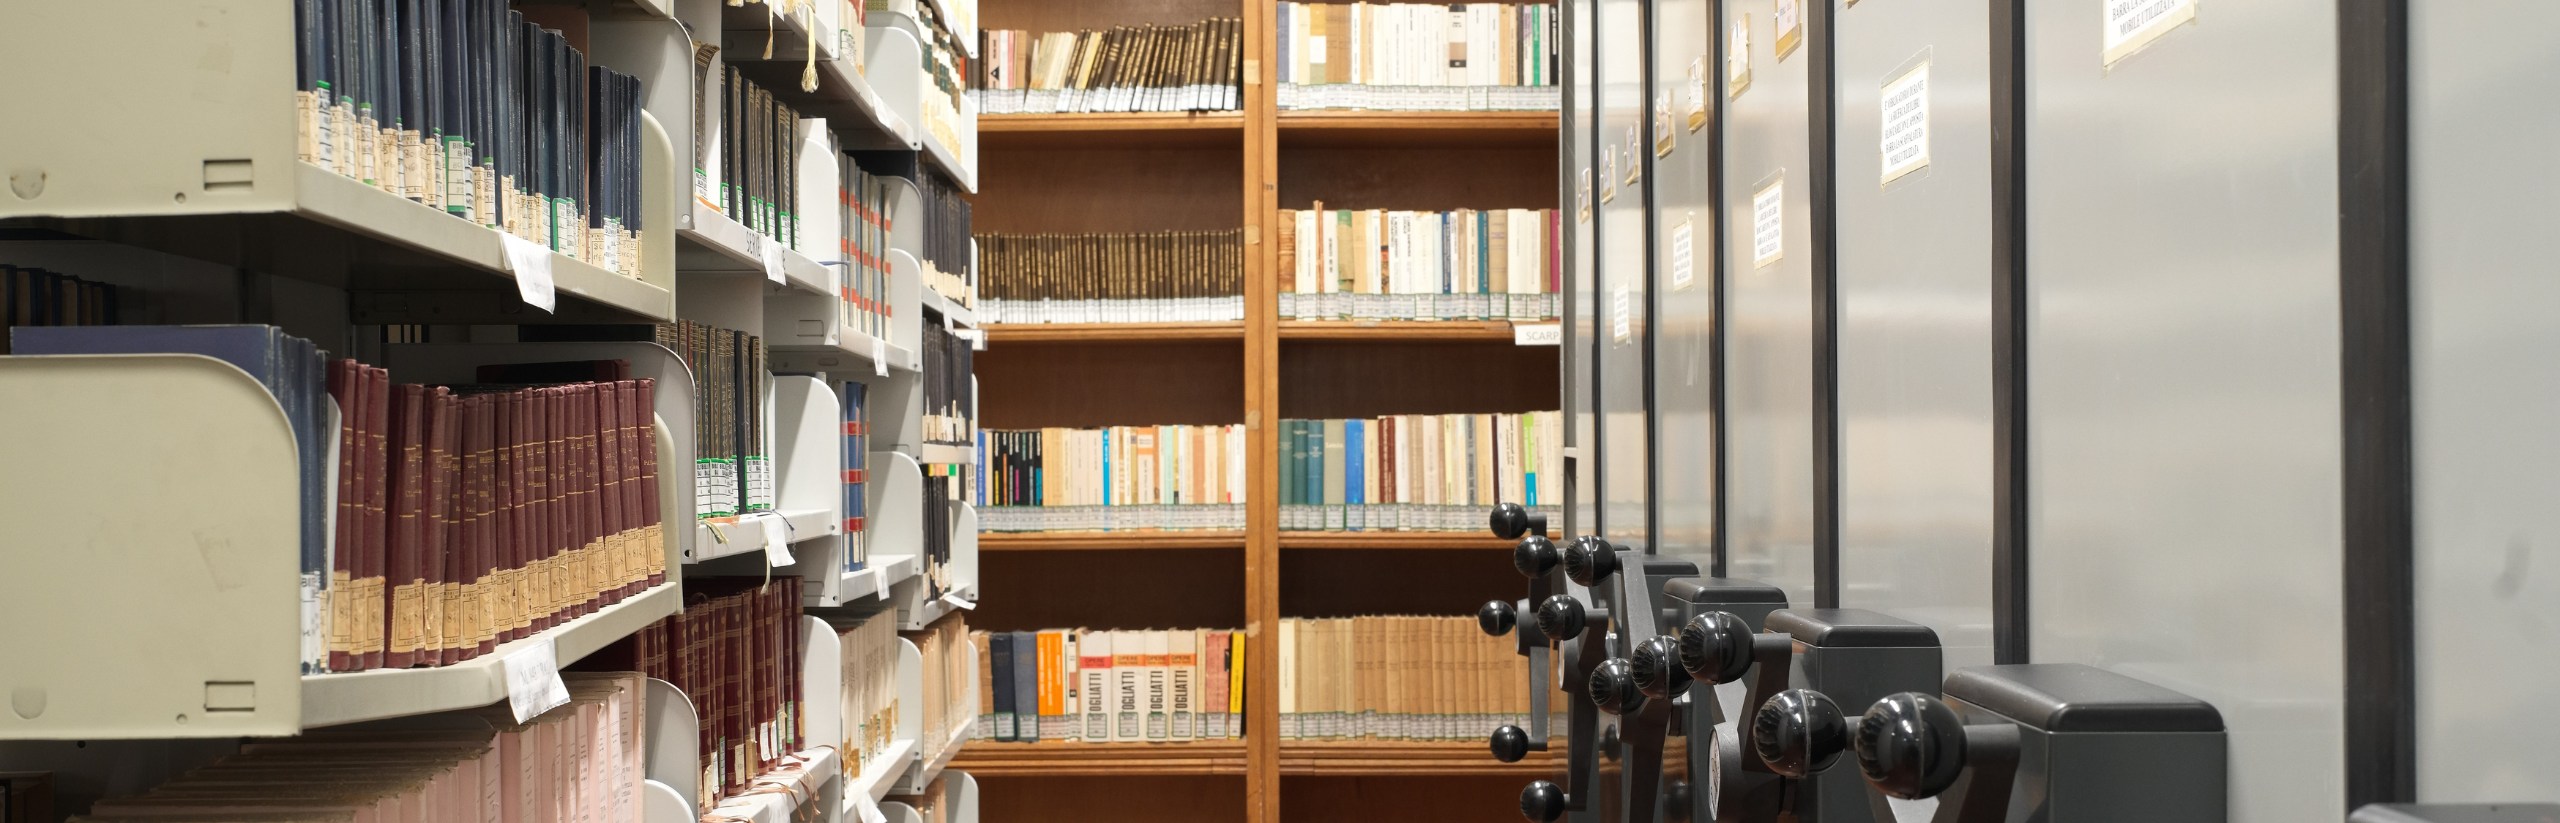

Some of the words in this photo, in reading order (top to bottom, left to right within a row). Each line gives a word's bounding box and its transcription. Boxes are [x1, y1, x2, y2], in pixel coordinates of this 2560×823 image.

[2112, 1, 2130, 21] BARRA
[2119, 13, 2140, 37] MOBILE
[1088, 673, 1102, 712] OGLIATTI
